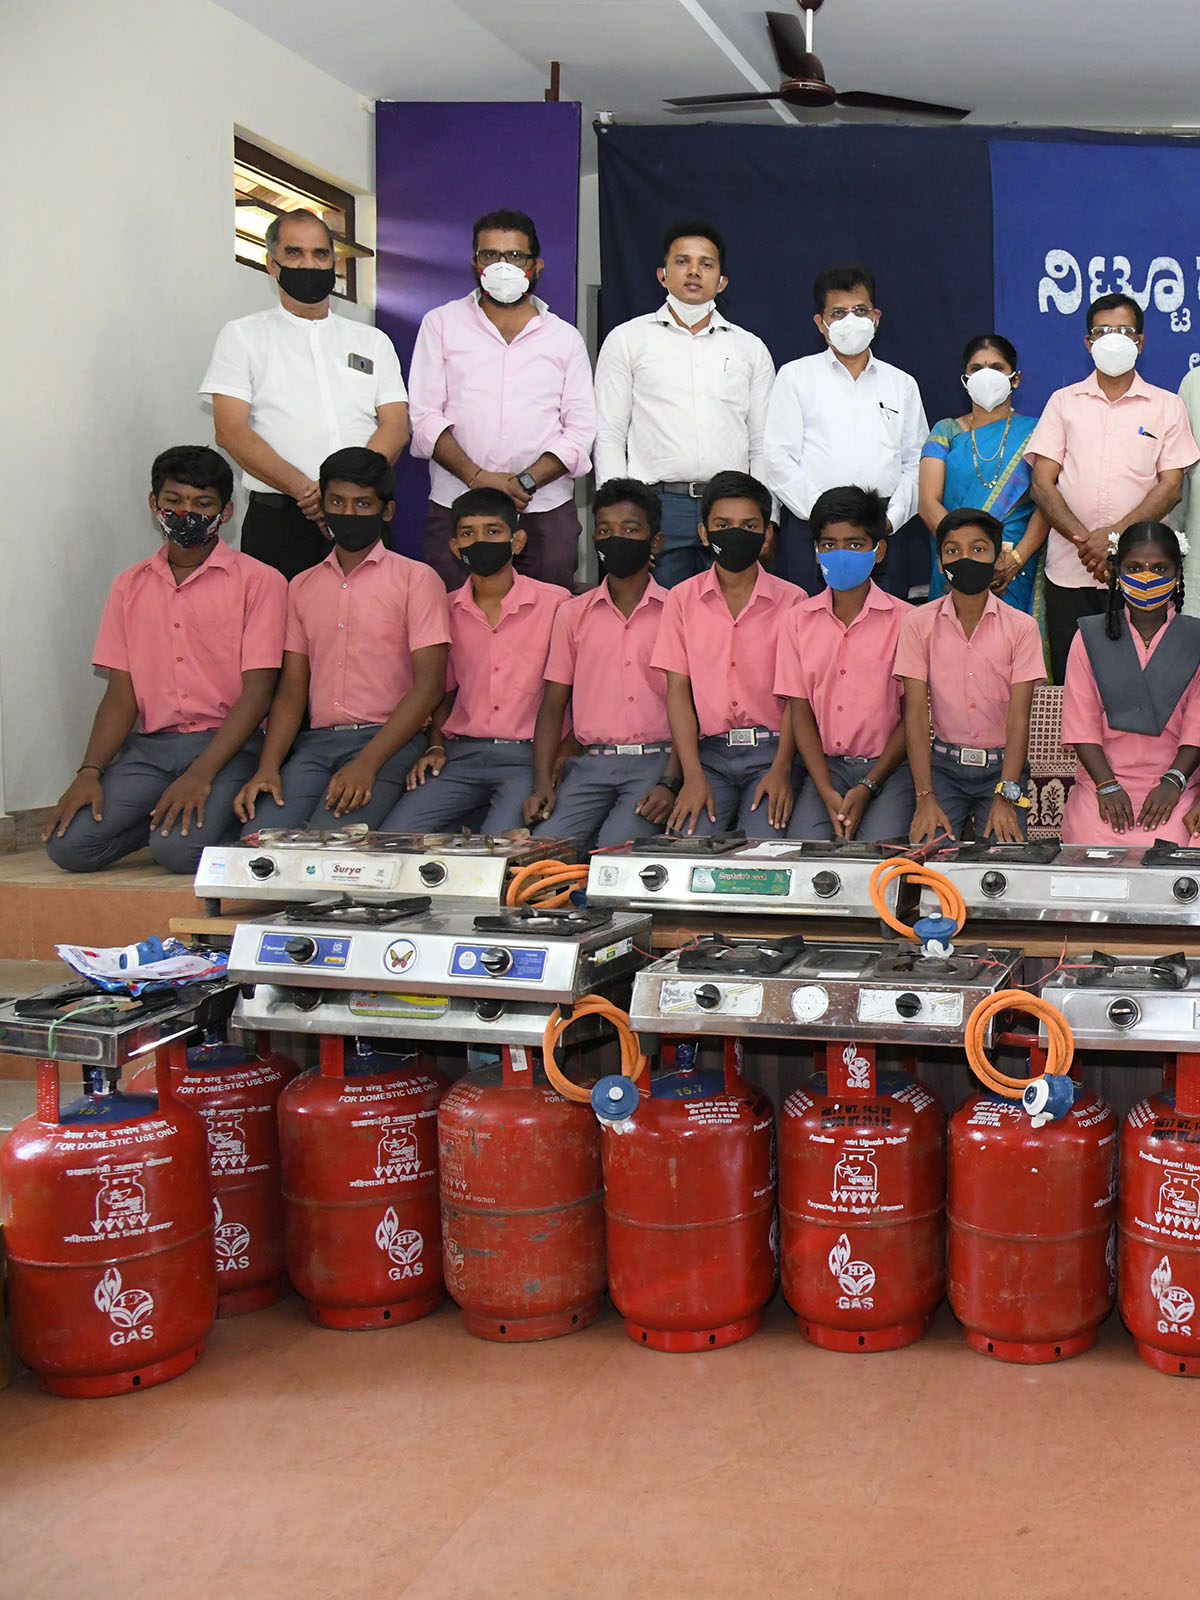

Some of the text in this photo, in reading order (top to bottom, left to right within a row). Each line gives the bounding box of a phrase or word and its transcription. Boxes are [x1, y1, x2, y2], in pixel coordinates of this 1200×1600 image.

[333, 864, 362, 875] Surya
[176, 1072, 282, 1094] FOR DOMESTIC USE ONLY
[846, 1078, 871, 1089] GAS
[359, 1089, 405, 1102] DOMESTIC
[407, 1086, 424, 1095] USE
[423, 1081, 439, 1091] ONLY
[1077, 1118, 1092, 1128] FOR
[55, 1126, 178, 1151] FOR DOMESTIC USE ONLY
[1162, 1159, 1182, 1169] Mantri
[838, 1204, 849, 1213] the
[850, 1204, 872, 1214] dignity
[221, 1226, 241, 1237] HP
[1161, 1226, 1170, 1235] the
[1171, 1229, 1194, 1240] dignity
[1194, 1232, 1200, 1240] of
[396, 1233, 416, 1246] HP
[215, 1256, 250, 1272] GAS
[848, 1265, 869, 1276] HP
[388, 1263, 424, 1281] GAS
[1167, 1290, 1188, 1302] HP
[838, 1296, 874, 1310] GAS
[1157, 1319, 1192, 1336] GAS
[110, 1325, 154, 1346] GAS
